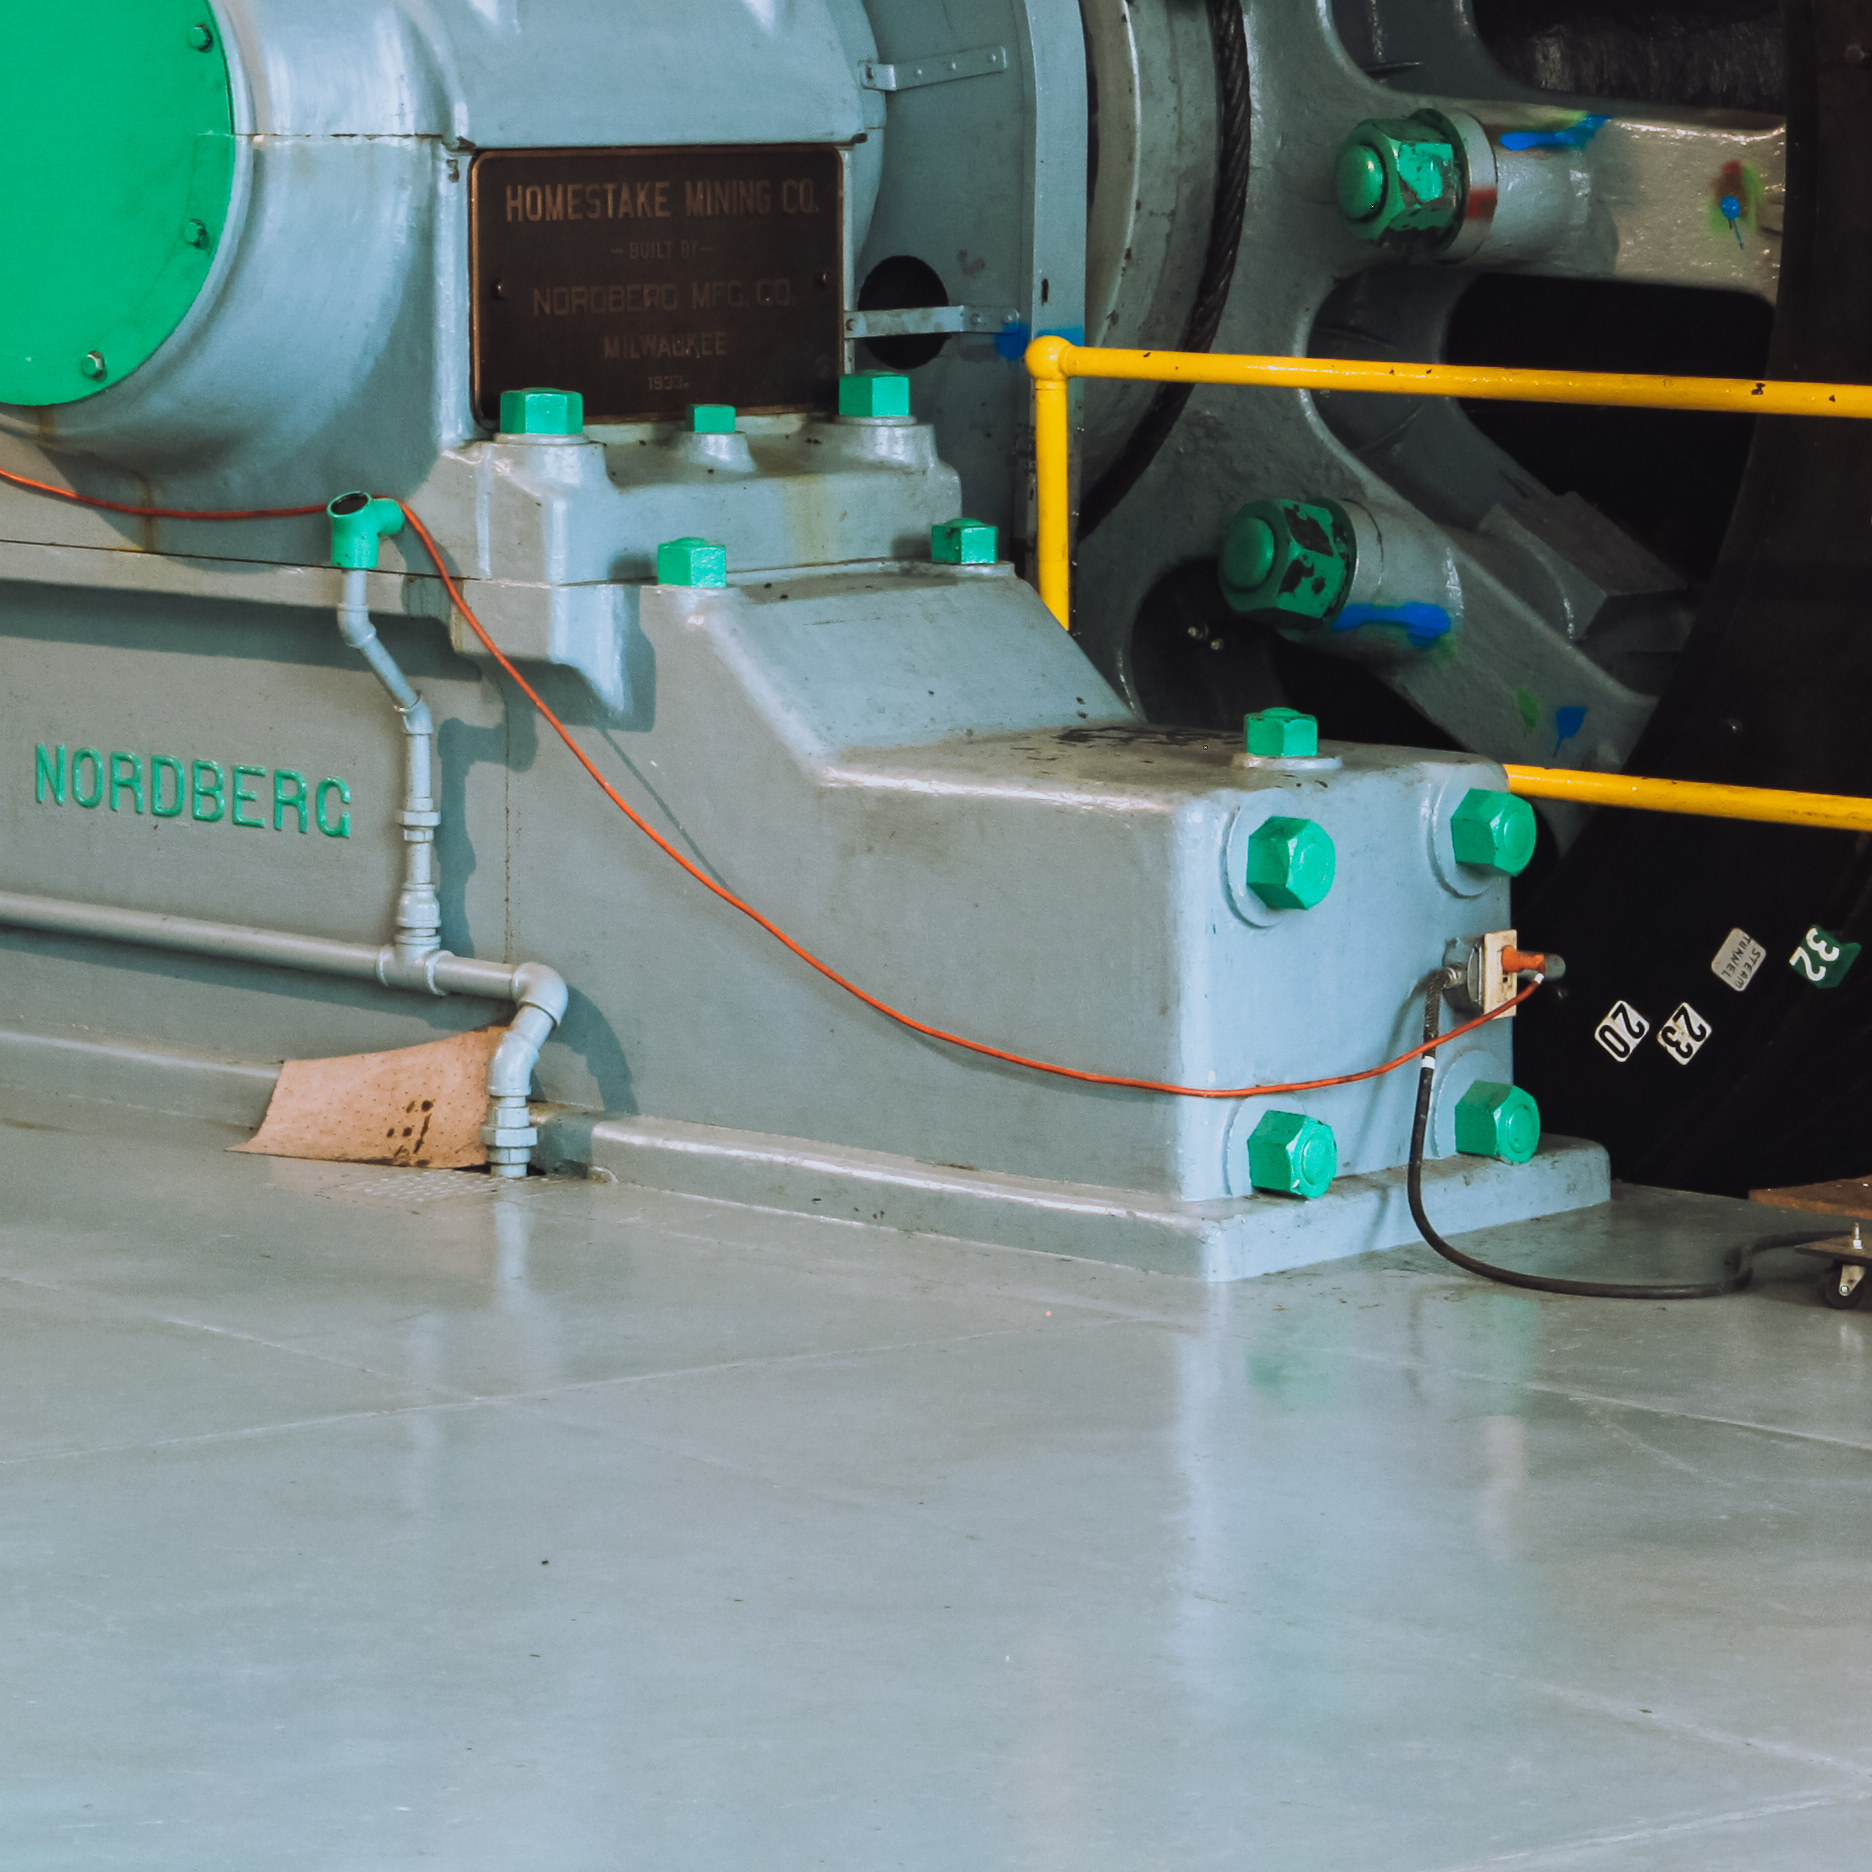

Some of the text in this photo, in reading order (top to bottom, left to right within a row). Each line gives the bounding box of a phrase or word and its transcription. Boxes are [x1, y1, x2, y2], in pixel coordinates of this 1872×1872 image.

[504, 181, 671, 223] HOMESTAKE
[685, 178, 772, 217] MINING
[629, 240, 673, 260] BUILT
[533, 282, 677, 316] NORDBERG
[603, 331, 727, 359] MILWAUKEE
[35, 742, 352, 839] NORDBERG
[1722, 936, 1752, 978] TUNNEL
[1734, 948, 1761, 989] STEAM
[1789, 927, 1840, 981] 32
[1599, 1003, 1646, 1059] 20
[1661, 1006, 1707, 1059] 23
